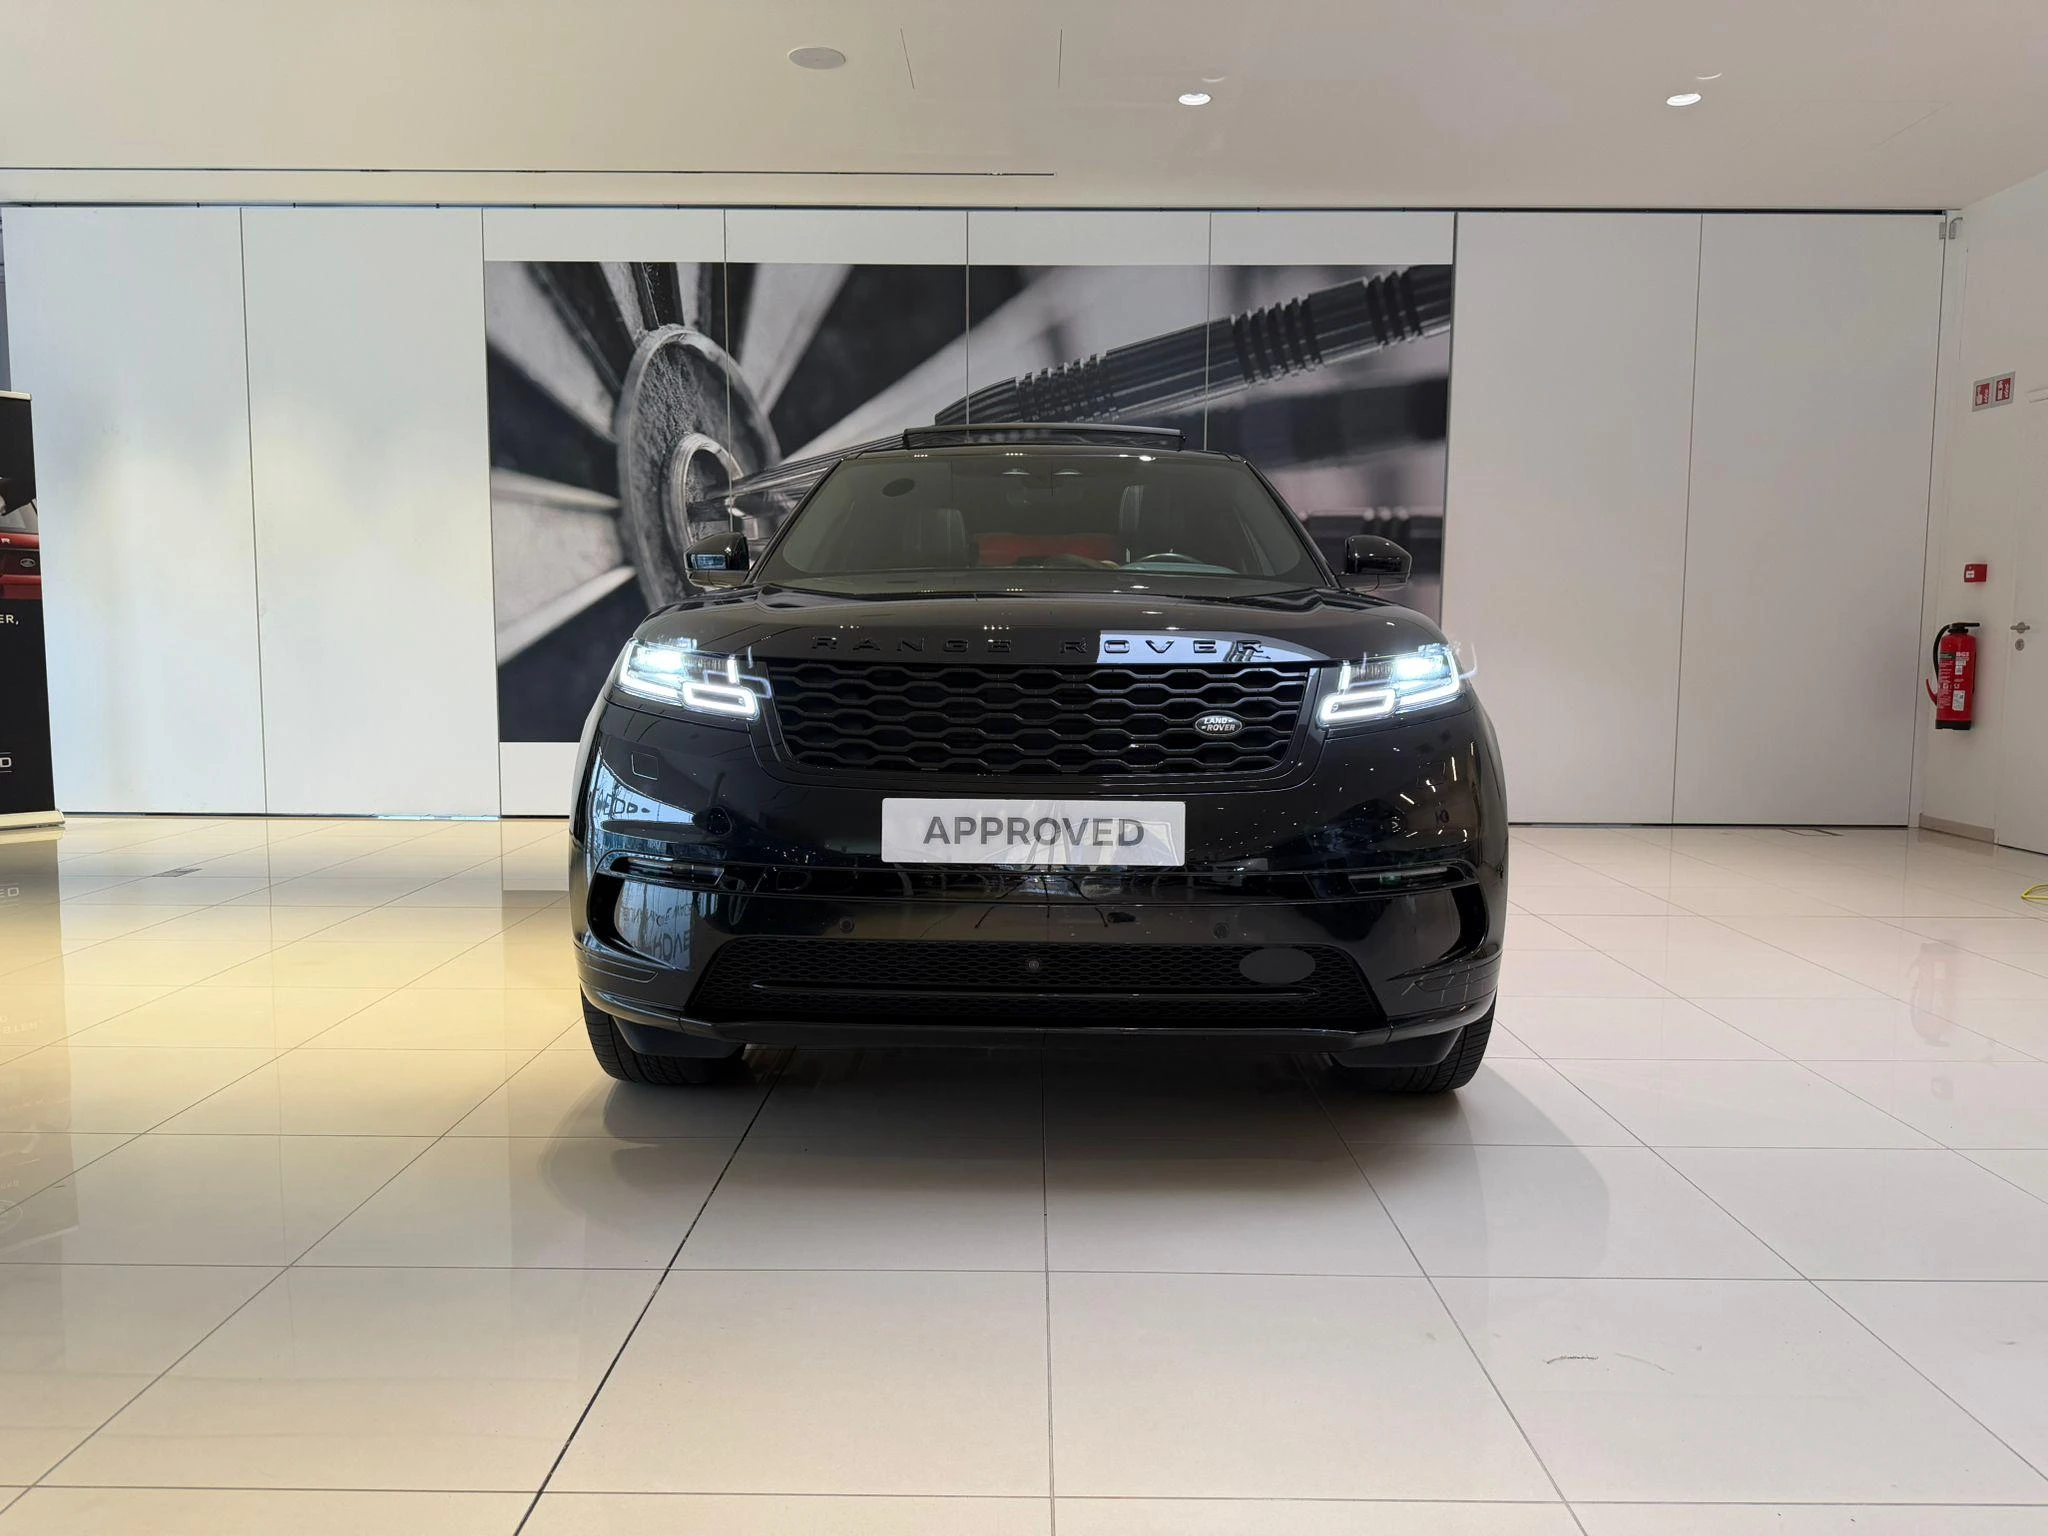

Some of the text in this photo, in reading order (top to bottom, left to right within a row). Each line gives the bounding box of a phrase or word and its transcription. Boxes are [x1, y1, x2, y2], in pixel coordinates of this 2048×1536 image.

[811, 636, 1264, 654] RANGE ROVER
[1204, 716, 1228, 724] LAND
[1206, 723, 1236, 731] ROVER
[922, 815, 1145, 847] APPROVED
